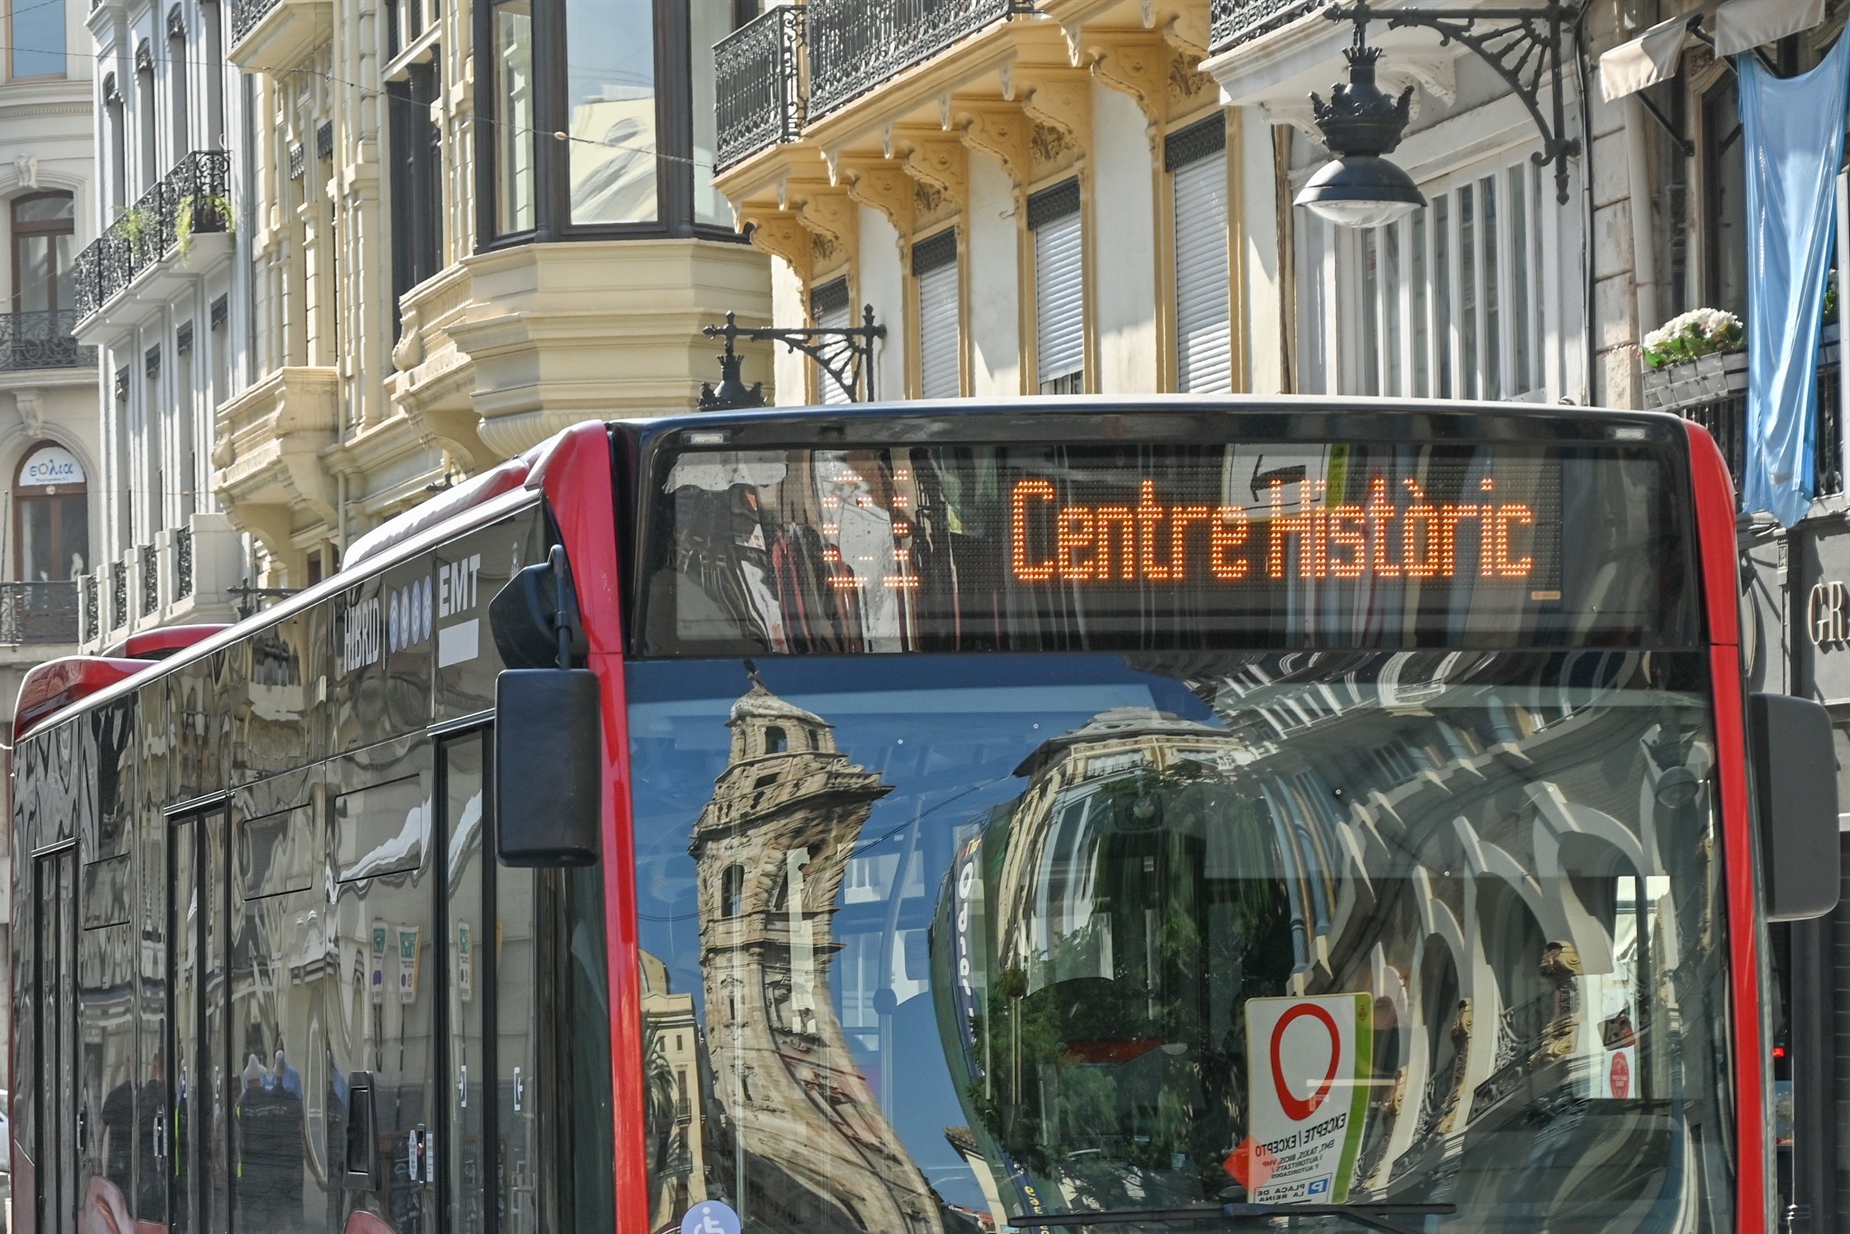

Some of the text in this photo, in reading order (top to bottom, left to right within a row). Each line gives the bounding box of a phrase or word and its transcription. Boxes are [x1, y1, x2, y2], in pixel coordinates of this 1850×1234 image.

[1011, 479, 1248, 580] Centre
[1270, 477, 1532, 578] Històric
[438, 553, 481, 619] EMT
[1807, 580, 1850, 645] GR
